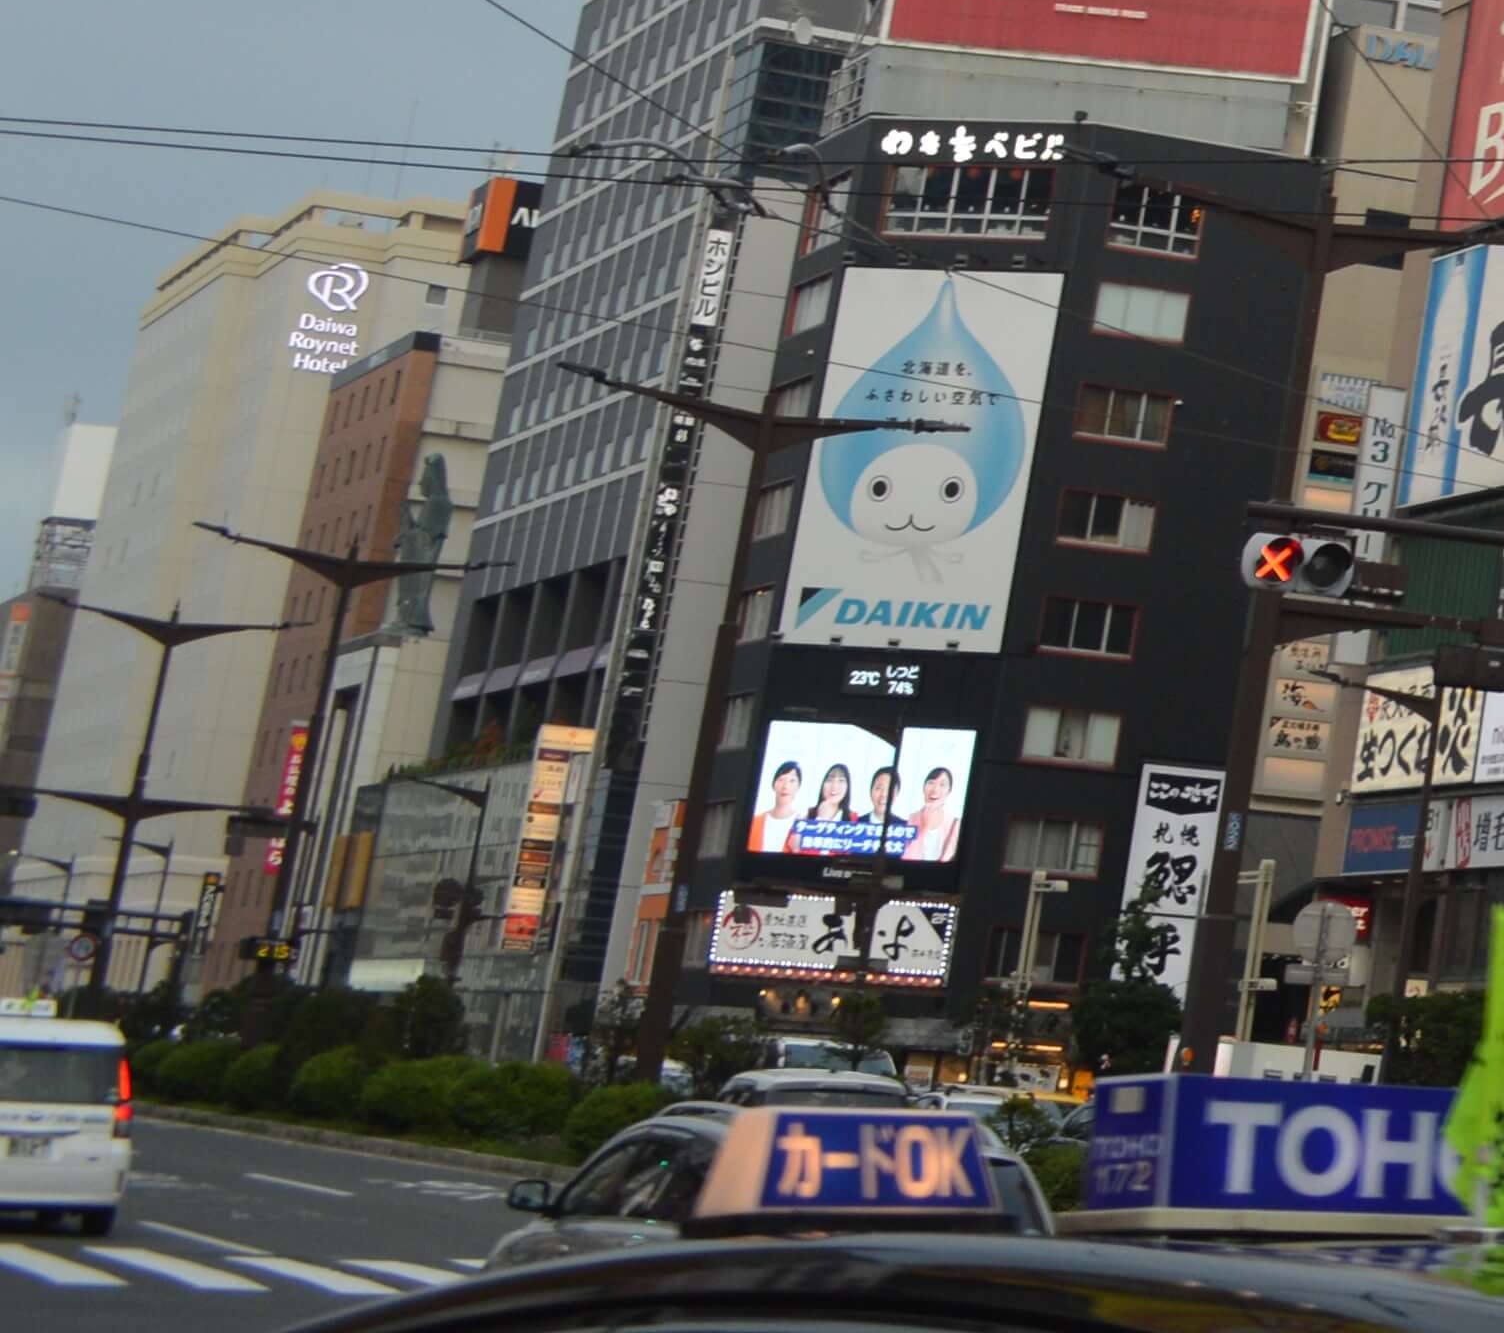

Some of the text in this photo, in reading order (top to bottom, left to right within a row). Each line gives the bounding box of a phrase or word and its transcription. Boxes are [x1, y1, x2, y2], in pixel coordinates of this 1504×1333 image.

[300, 312, 358, 337] Daiwa
[288, 332, 359, 357] Roynet
[293, 353, 348, 374] Hotel
[902, 360, 972, 377] 北海道を、
[833, 598, 990, 630] DAIKIN
[886, 664, 920, 679] しつど
[1153, 823, 1200, 847] 札幌
[777, 1121, 974, 1199] カードOK
[1204, 1100, 1460, 1200] TOH
